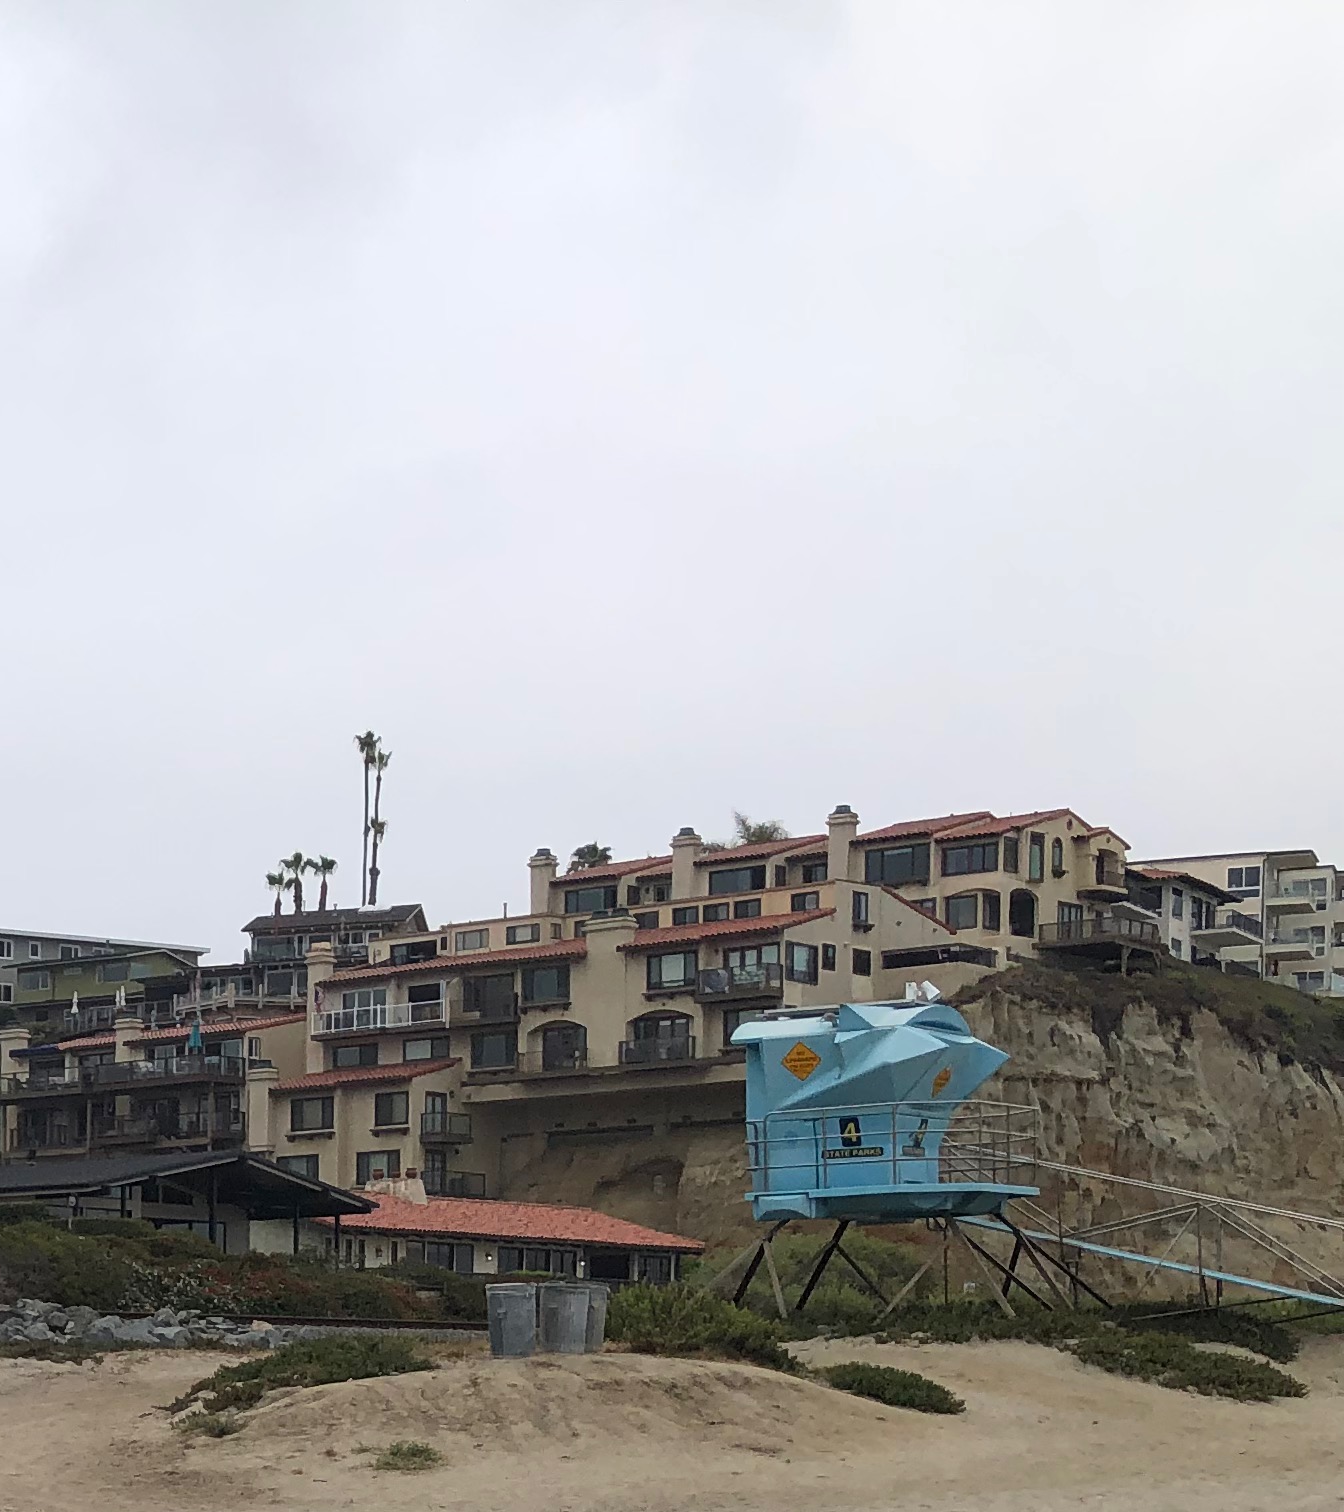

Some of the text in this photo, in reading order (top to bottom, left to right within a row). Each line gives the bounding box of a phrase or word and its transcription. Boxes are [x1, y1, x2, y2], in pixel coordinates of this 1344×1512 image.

[843, 1122, 858, 1142] 4
[823, 1147, 882, 1159] STATE PARKS
